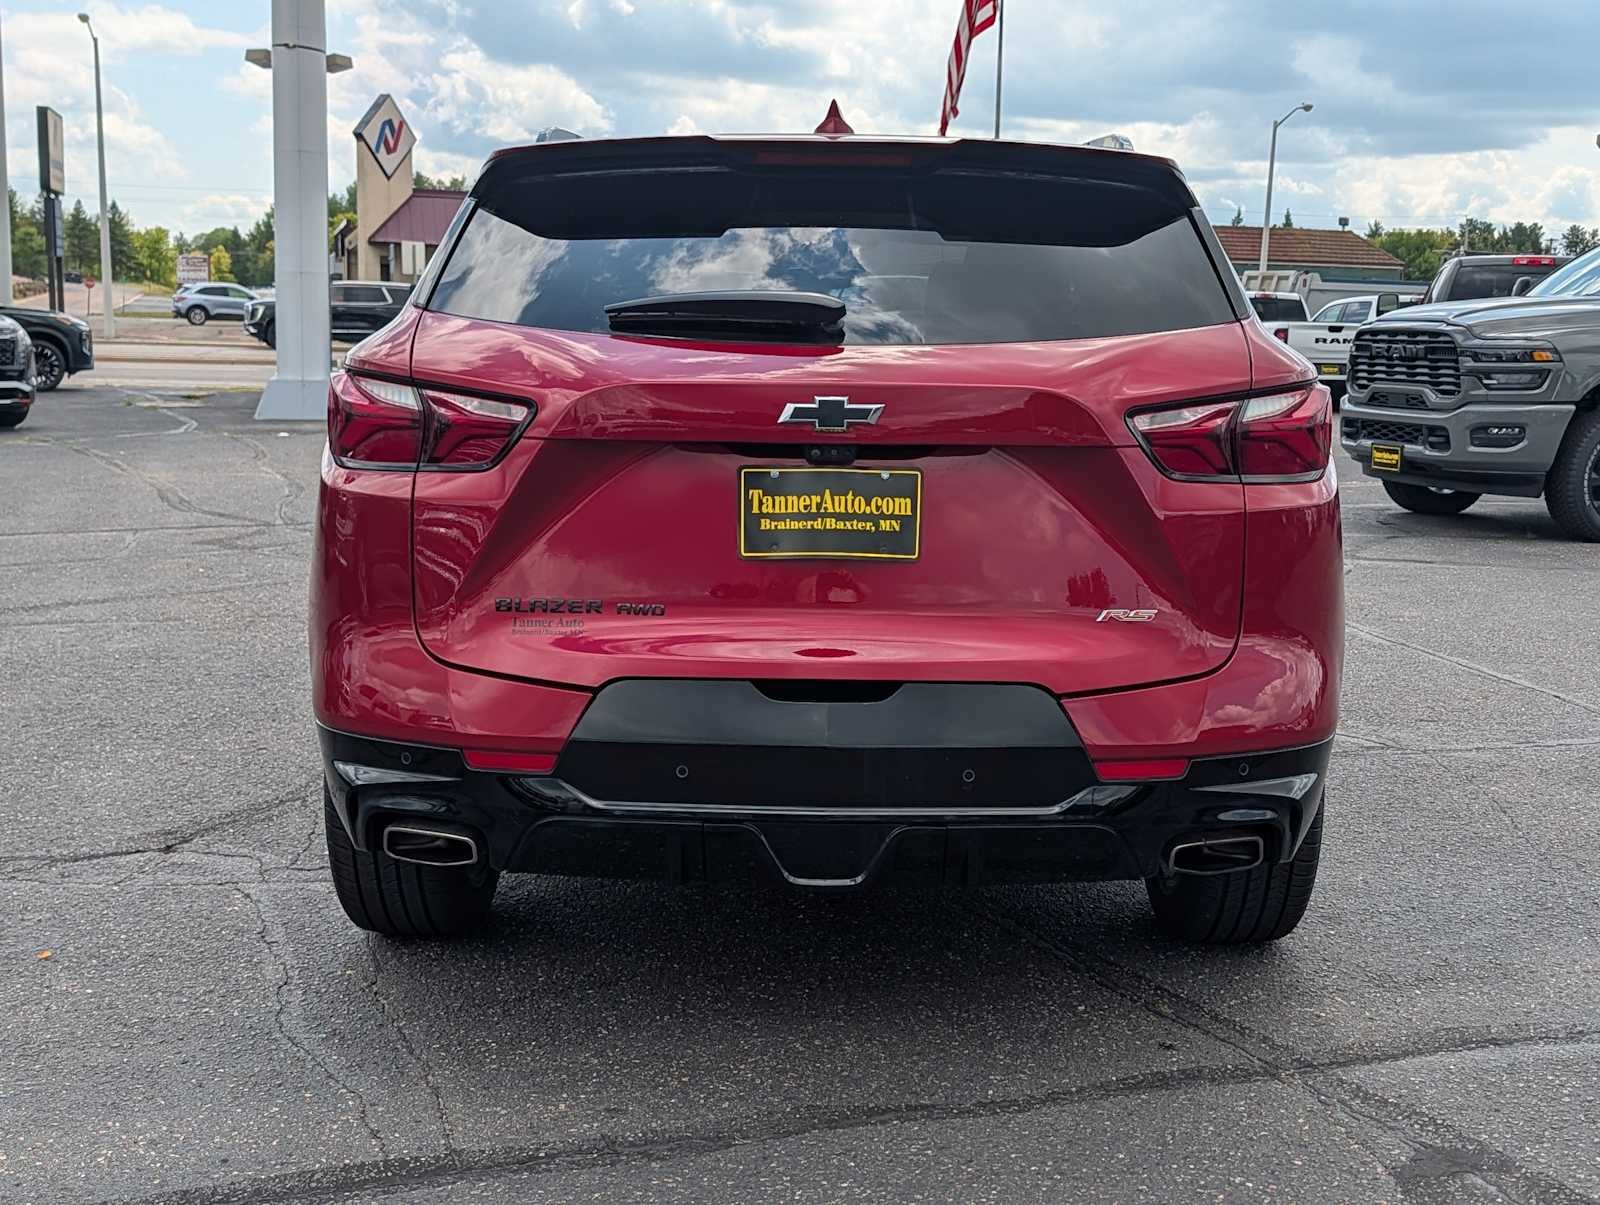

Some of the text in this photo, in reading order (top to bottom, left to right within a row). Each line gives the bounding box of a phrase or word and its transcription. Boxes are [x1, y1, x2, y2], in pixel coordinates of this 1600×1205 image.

[1371, 343, 1425, 358] RAM
[748, 489, 912, 516] TannerAuto.com
[759, 518, 901, 533] Brainerd/Baxter, MN
[495, 598, 666, 616] BLAZER AWD
[1096, 609, 1158, 622] RS
